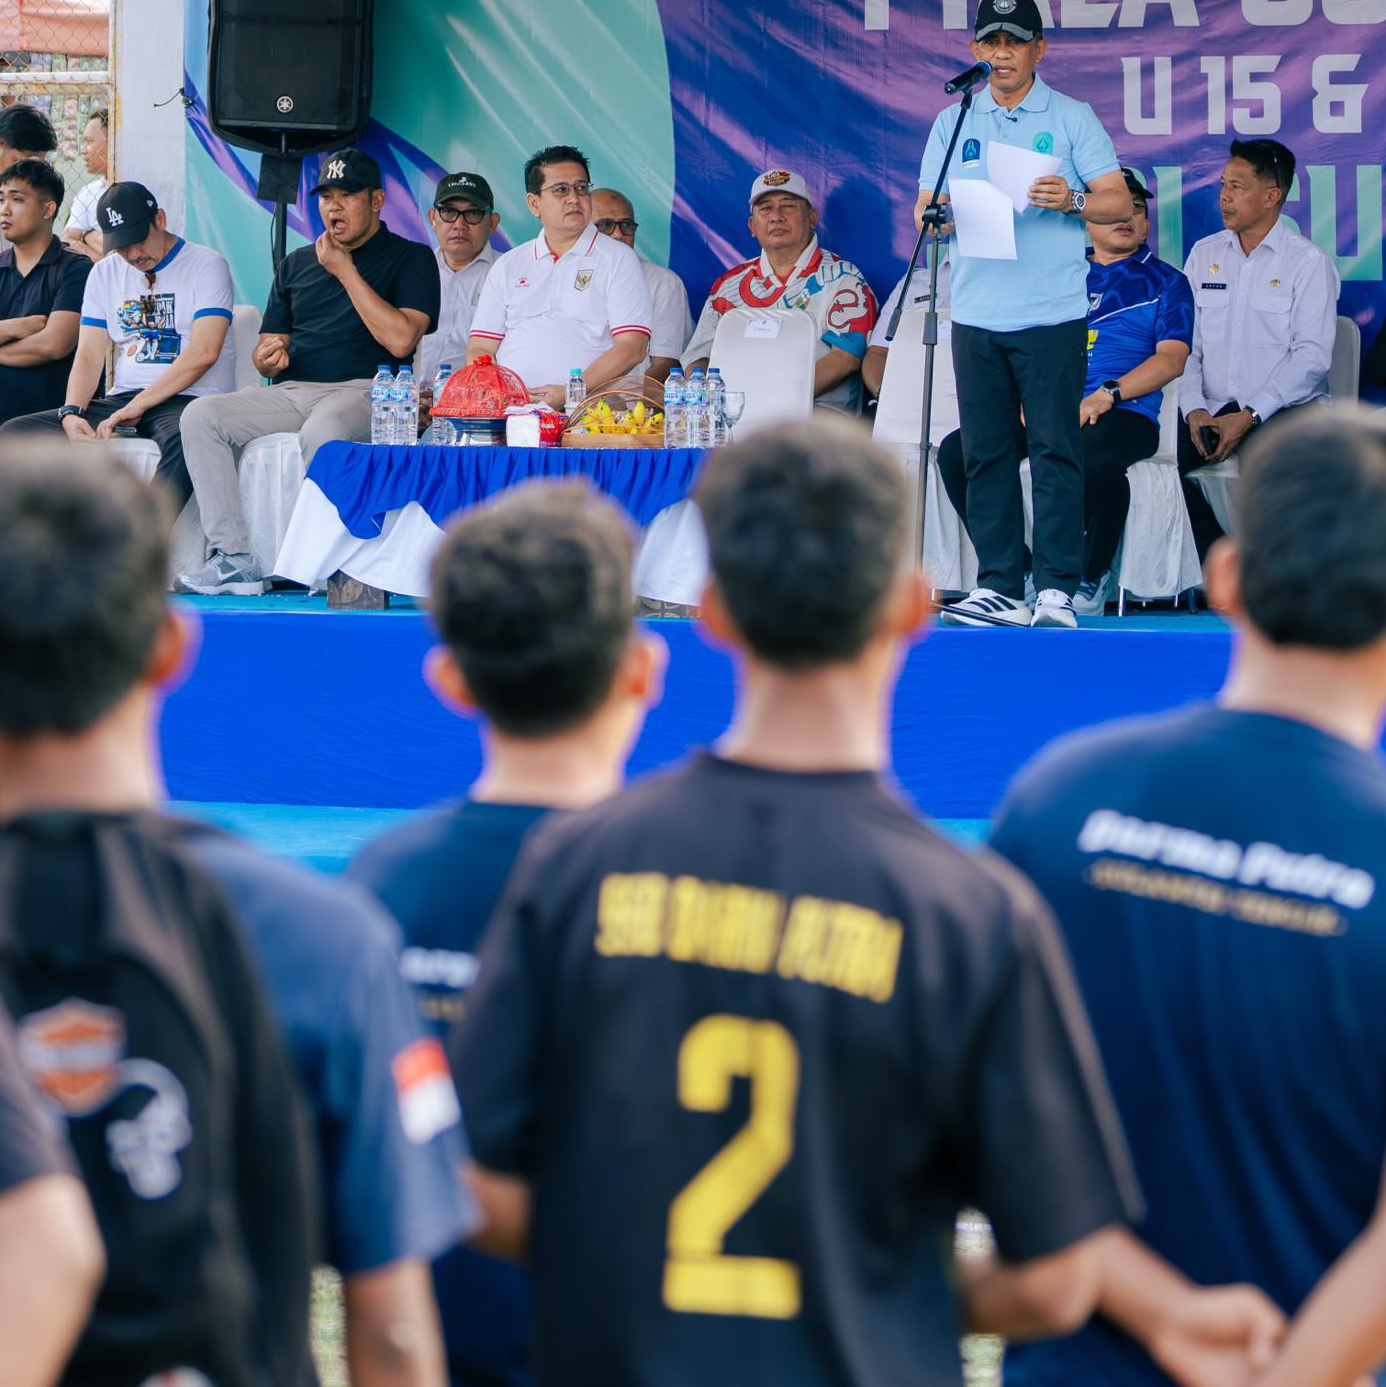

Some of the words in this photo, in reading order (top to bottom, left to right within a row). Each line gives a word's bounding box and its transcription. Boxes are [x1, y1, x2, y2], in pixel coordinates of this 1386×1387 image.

[1120, 56, 1172, 135] U
[1200, 55, 1282, 135] 15
[1312, 53, 1368, 133] &
[326, 159, 346, 180] NY
[106, 207, 125, 227] LA
[662, 1014, 801, 1320] 2
